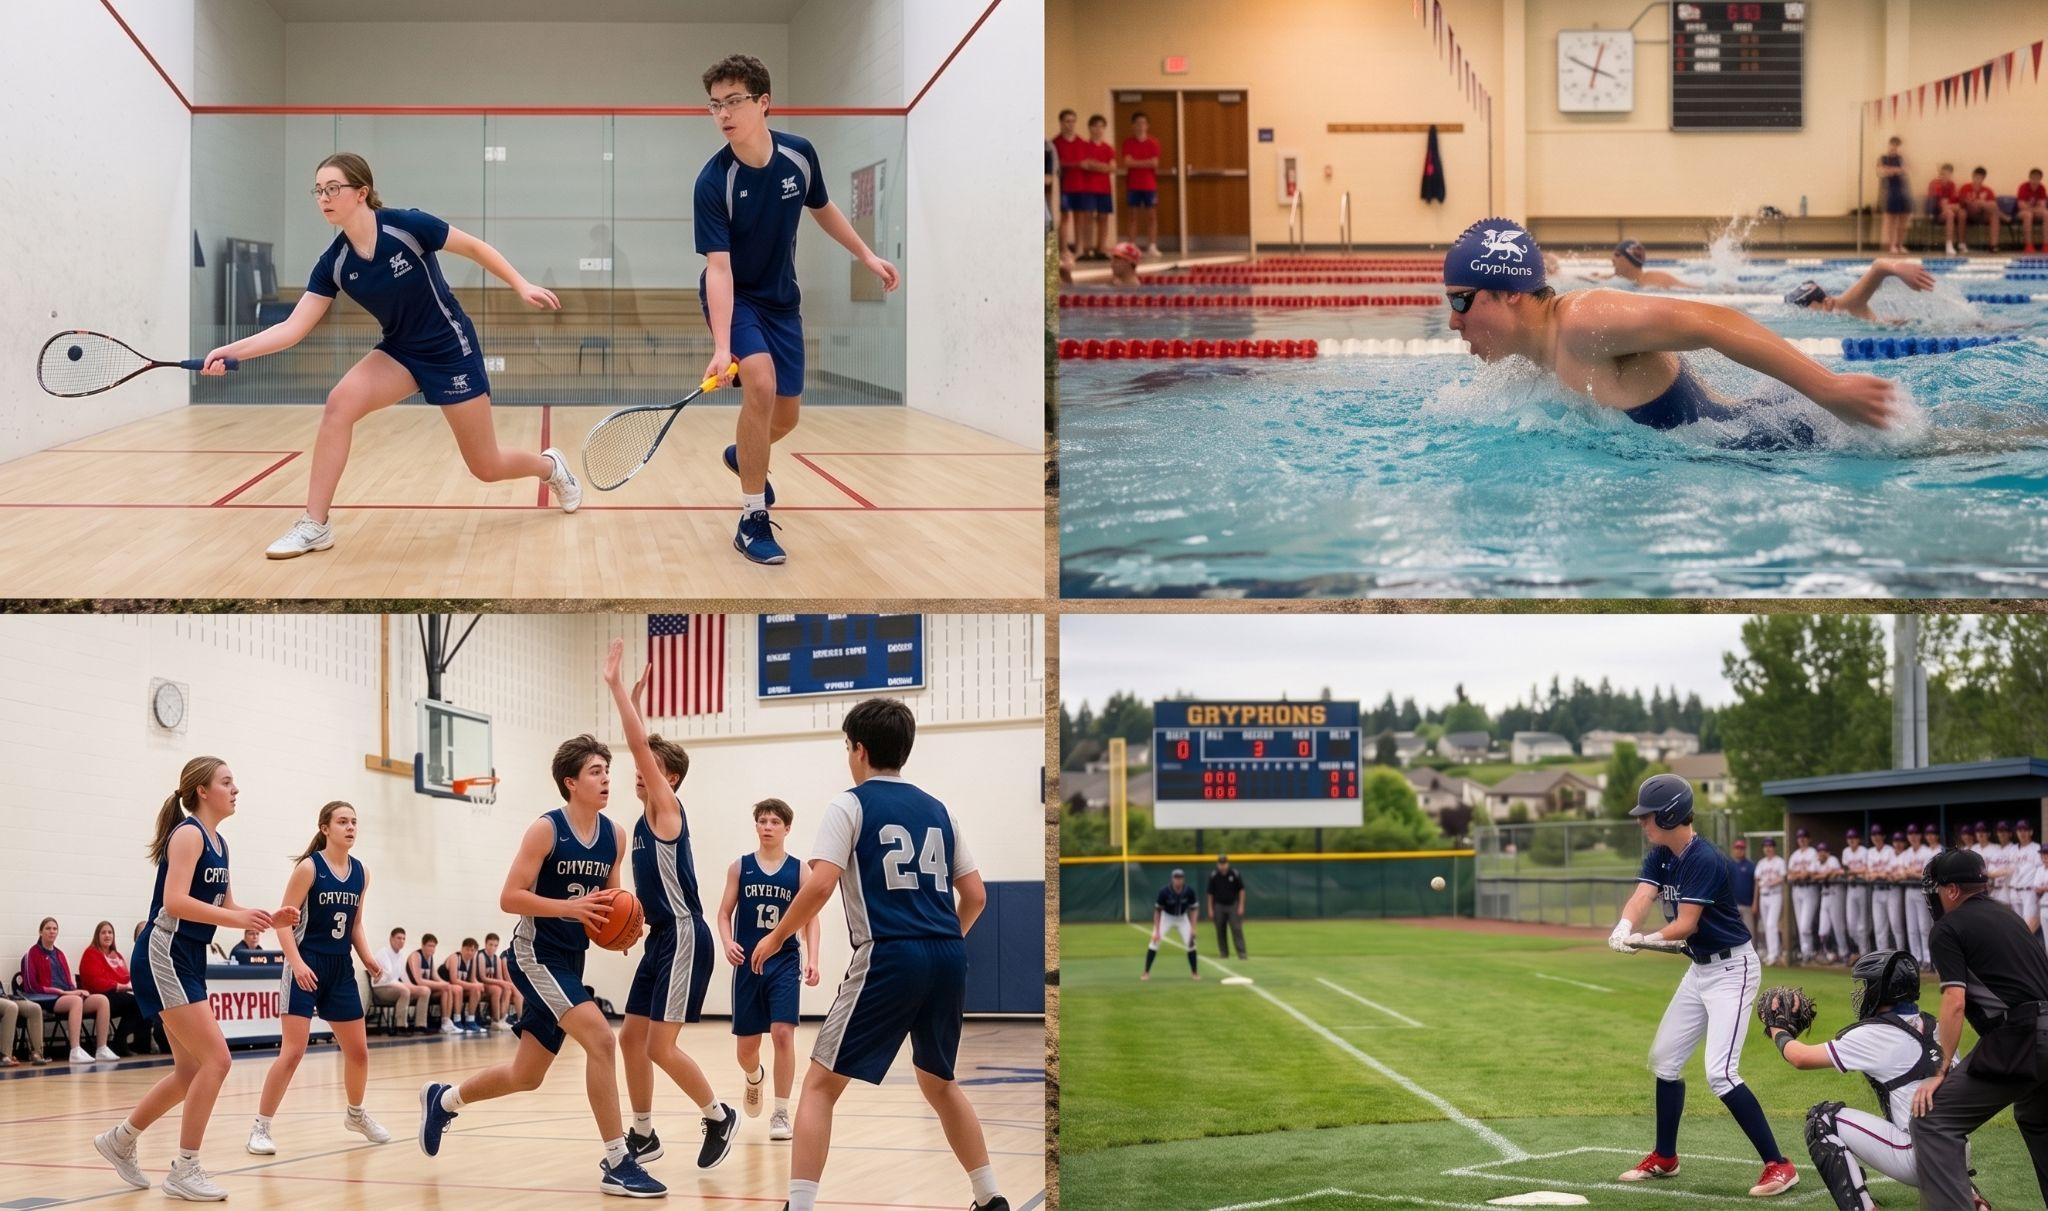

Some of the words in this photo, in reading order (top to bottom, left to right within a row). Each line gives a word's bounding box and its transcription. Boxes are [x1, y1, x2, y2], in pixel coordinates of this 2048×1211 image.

[1470, 260, 1533, 276] Gryphons
[1187, 705, 1327, 726] GRYPHONS
[1177, 740, 1189, 760] 0
[1253, 740, 1264, 757] 3
[879, 824, 949, 893] 24
[331, 911, 347, 940] 3
[756, 903, 780, 930] 13
[209, 991, 280, 1021] GRYPHO
